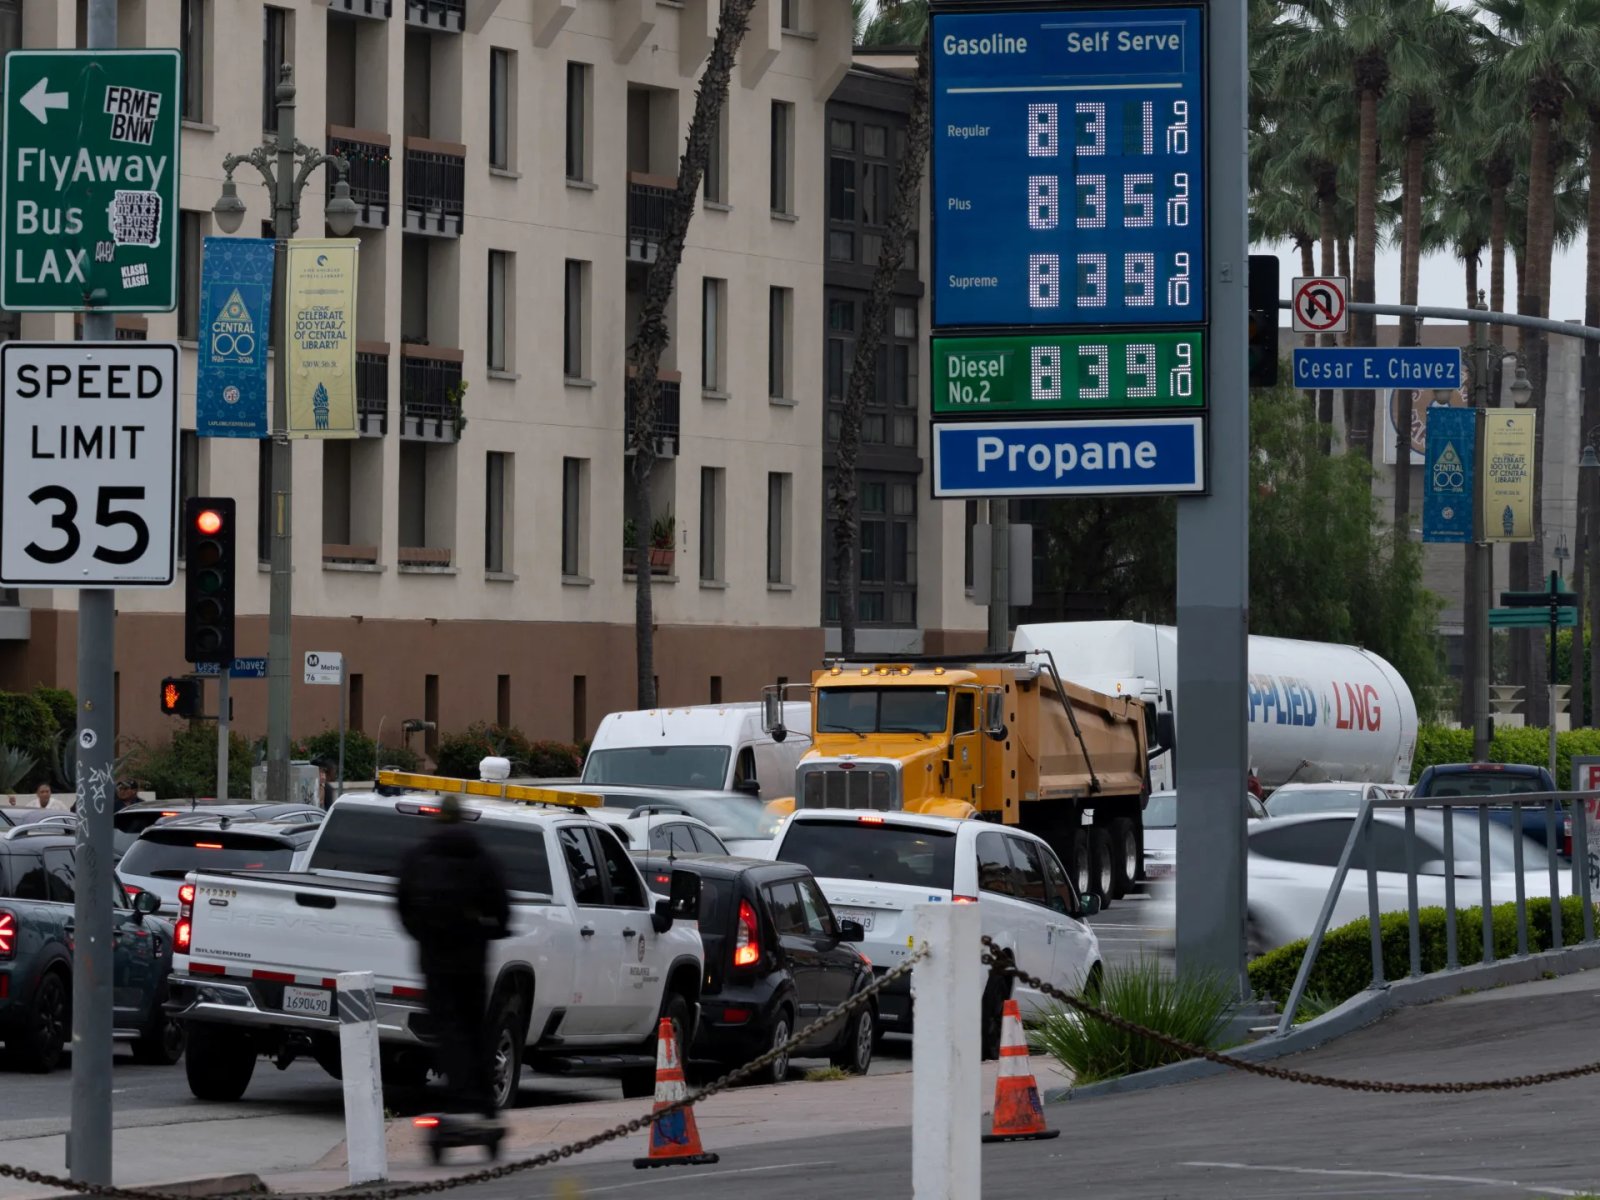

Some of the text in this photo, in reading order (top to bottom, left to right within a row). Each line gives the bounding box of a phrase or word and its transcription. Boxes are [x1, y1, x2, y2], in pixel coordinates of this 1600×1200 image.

[943, 33, 1027, 55] Gasoline
[1067, 31, 1179, 52] Self Serve
[106, 87, 159, 118] FRME
[112, 114, 154, 144] BNW
[947, 124, 990, 140] Regular
[17, 148, 167, 191] FlyAway
[116, 204, 156, 216] DRAKE
[948, 198, 971, 210] Plus
[17, 200, 83, 234] Bus
[116, 227, 153, 239] HINTS
[16, 249, 87, 284] LAX
[949, 275, 998, 289] Supreme
[295, 320, 346, 330] 100 YEARS
[298, 310, 343, 320] CELEBRATE
[212, 322, 255, 333] CENTRAL
[294, 330, 347, 340] OF CENTRAL
[211, 333, 255, 355] 100
[302, 341, 339, 350] LIBRARY!
[948, 354, 1004, 378] Diesel
[1299, 358, 1455, 379] Cesar E. Chavez
[16, 364, 163, 399] SPEED
[948, 380, 991, 403] No.2
[31, 425, 145, 459] LIMIT
[977, 436, 1157, 480] Propane
[1433, 464, 1464, 472] CENTRAL
[1433, 471, 1464, 487] 100
[23, 485, 150, 565] 35
[235, 659, 265, 670] Chavez
[1248, 674, 1381, 731] PPLIED LNG
[208, 908, 400, 941] CHEVROLE
[195, 947, 251, 958] SILVERADO
[286, 996, 328, 1011] 1690490
